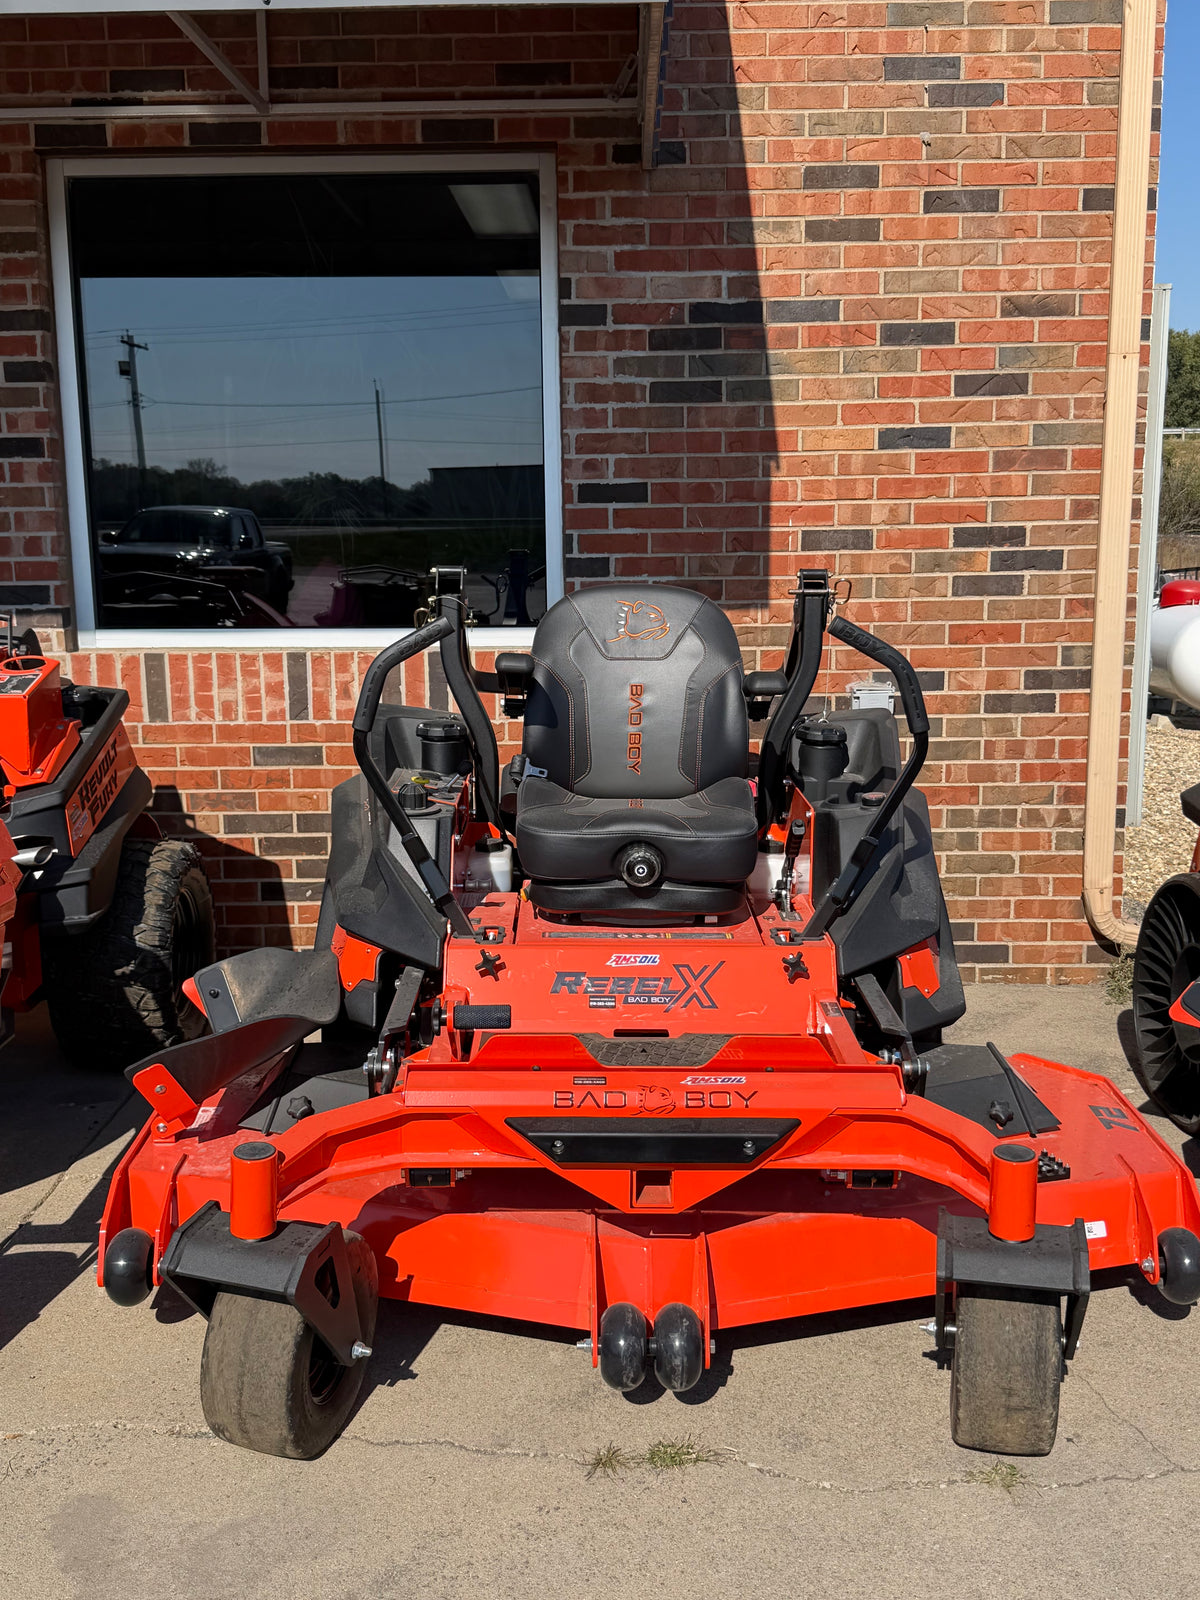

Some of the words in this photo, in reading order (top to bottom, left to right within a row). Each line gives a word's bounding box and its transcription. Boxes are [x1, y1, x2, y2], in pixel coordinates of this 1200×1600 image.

[628, 683, 644, 727] BAD
[627, 732, 642, 775] BOY
[78, 737, 118, 812] REVOLT
[87, 769, 118, 827] FURY
[608, 954, 660, 966] AMSOIL
[684, 1076, 746, 1085] AMSOIL
[553, 1090, 627, 1109] BAD
[685, 1090, 759, 1109] BOY
[1088, 1104, 1140, 1132] 72
